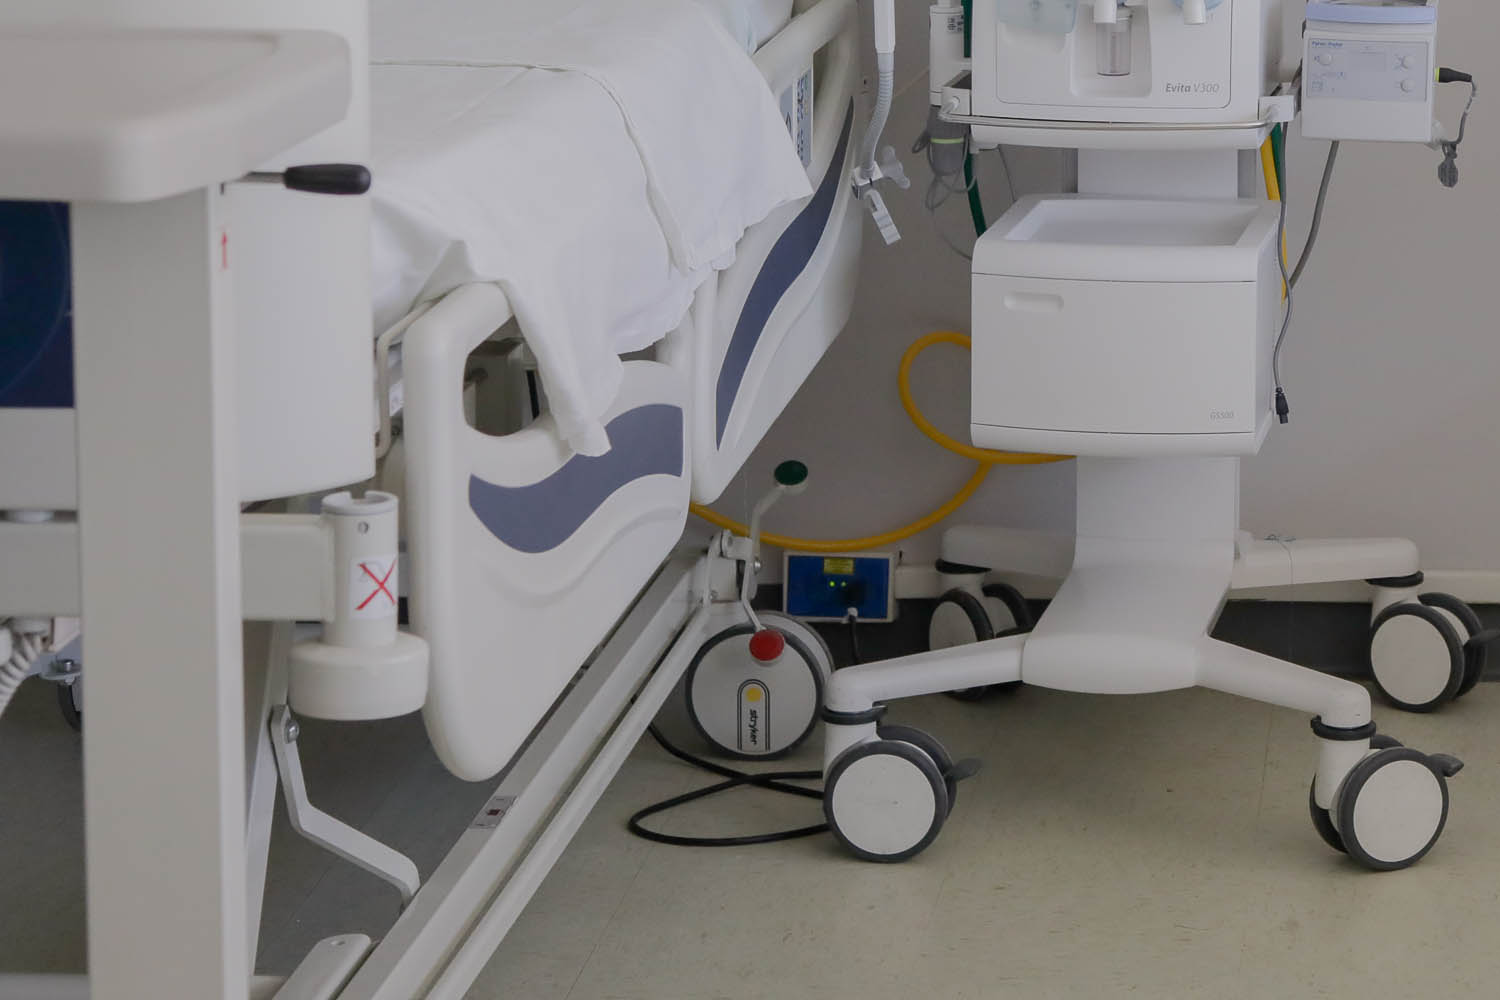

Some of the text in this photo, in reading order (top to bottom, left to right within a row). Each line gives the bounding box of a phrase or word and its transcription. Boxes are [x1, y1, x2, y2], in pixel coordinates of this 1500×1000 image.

[1165, 82, 1220, 93] Evita V300
[748, 708, 759, 746] stryker
